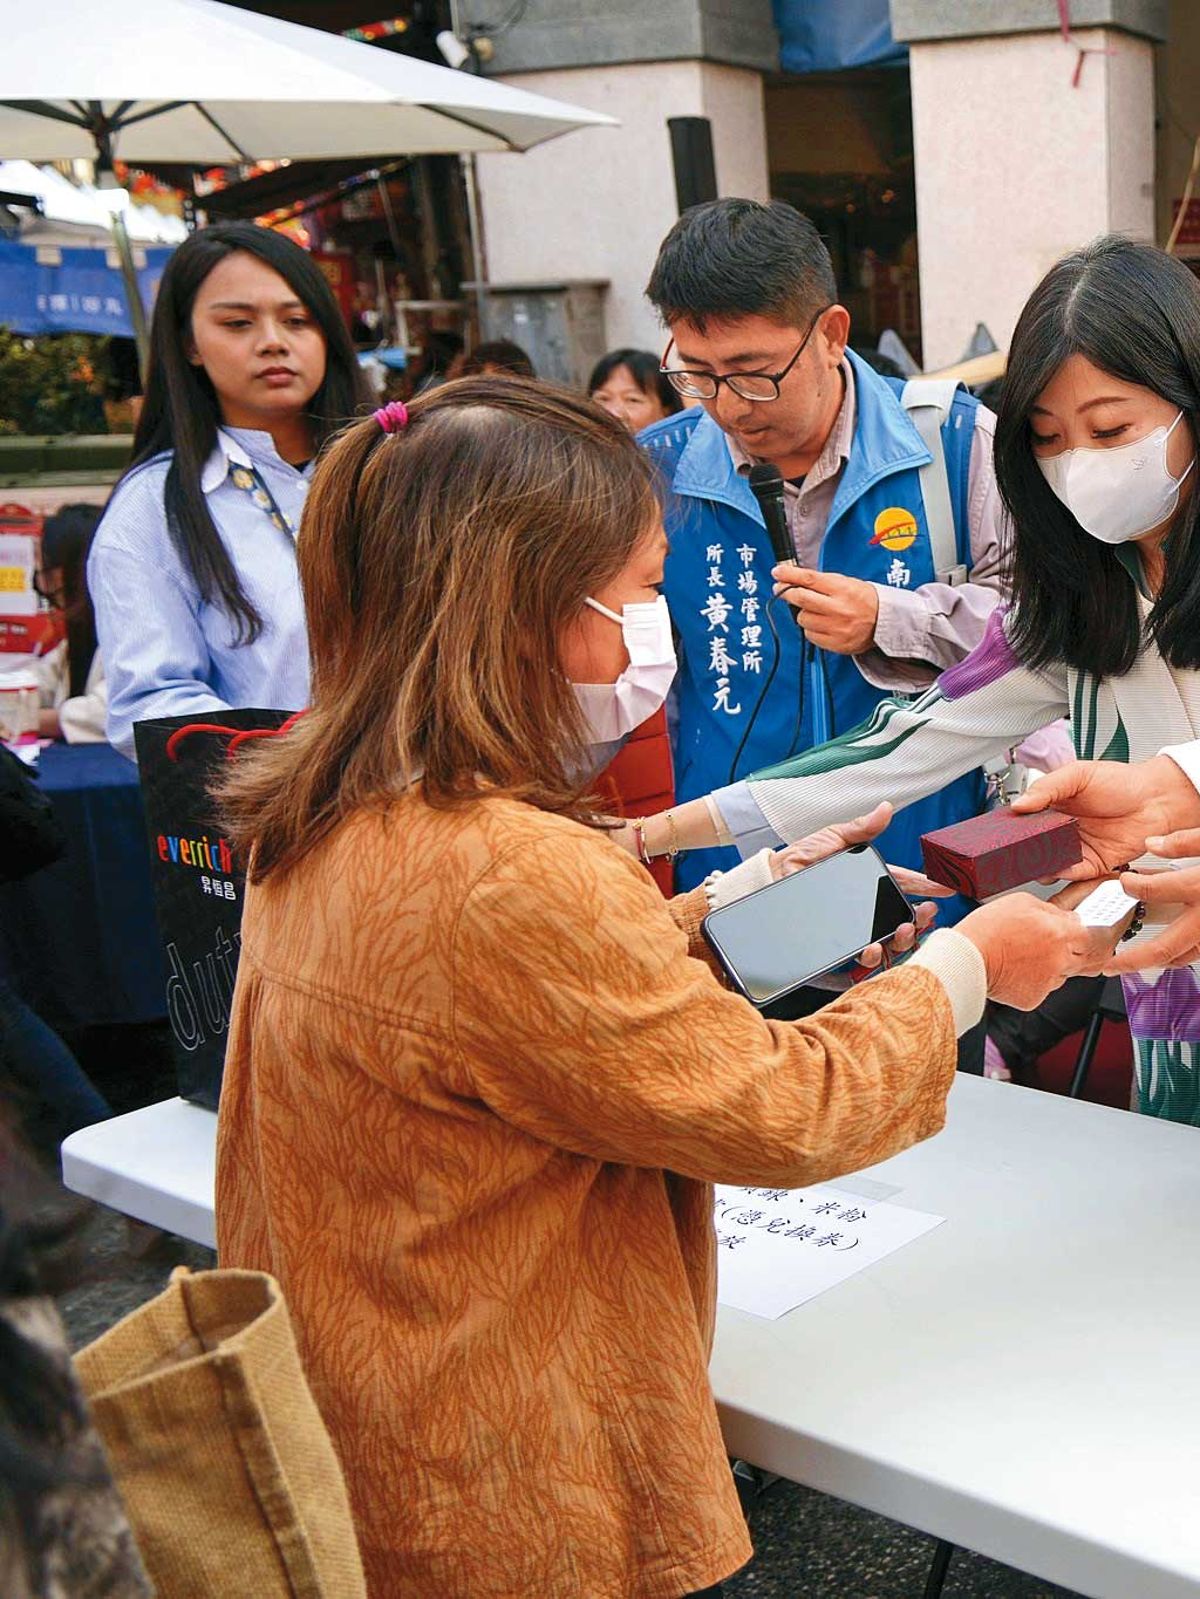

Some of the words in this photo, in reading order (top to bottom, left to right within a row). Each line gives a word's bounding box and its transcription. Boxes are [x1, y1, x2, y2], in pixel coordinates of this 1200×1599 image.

[736, 543, 764, 674] 市場管理所
[157, 835, 232, 875] everrich
[167, 927, 242, 1051] dut
